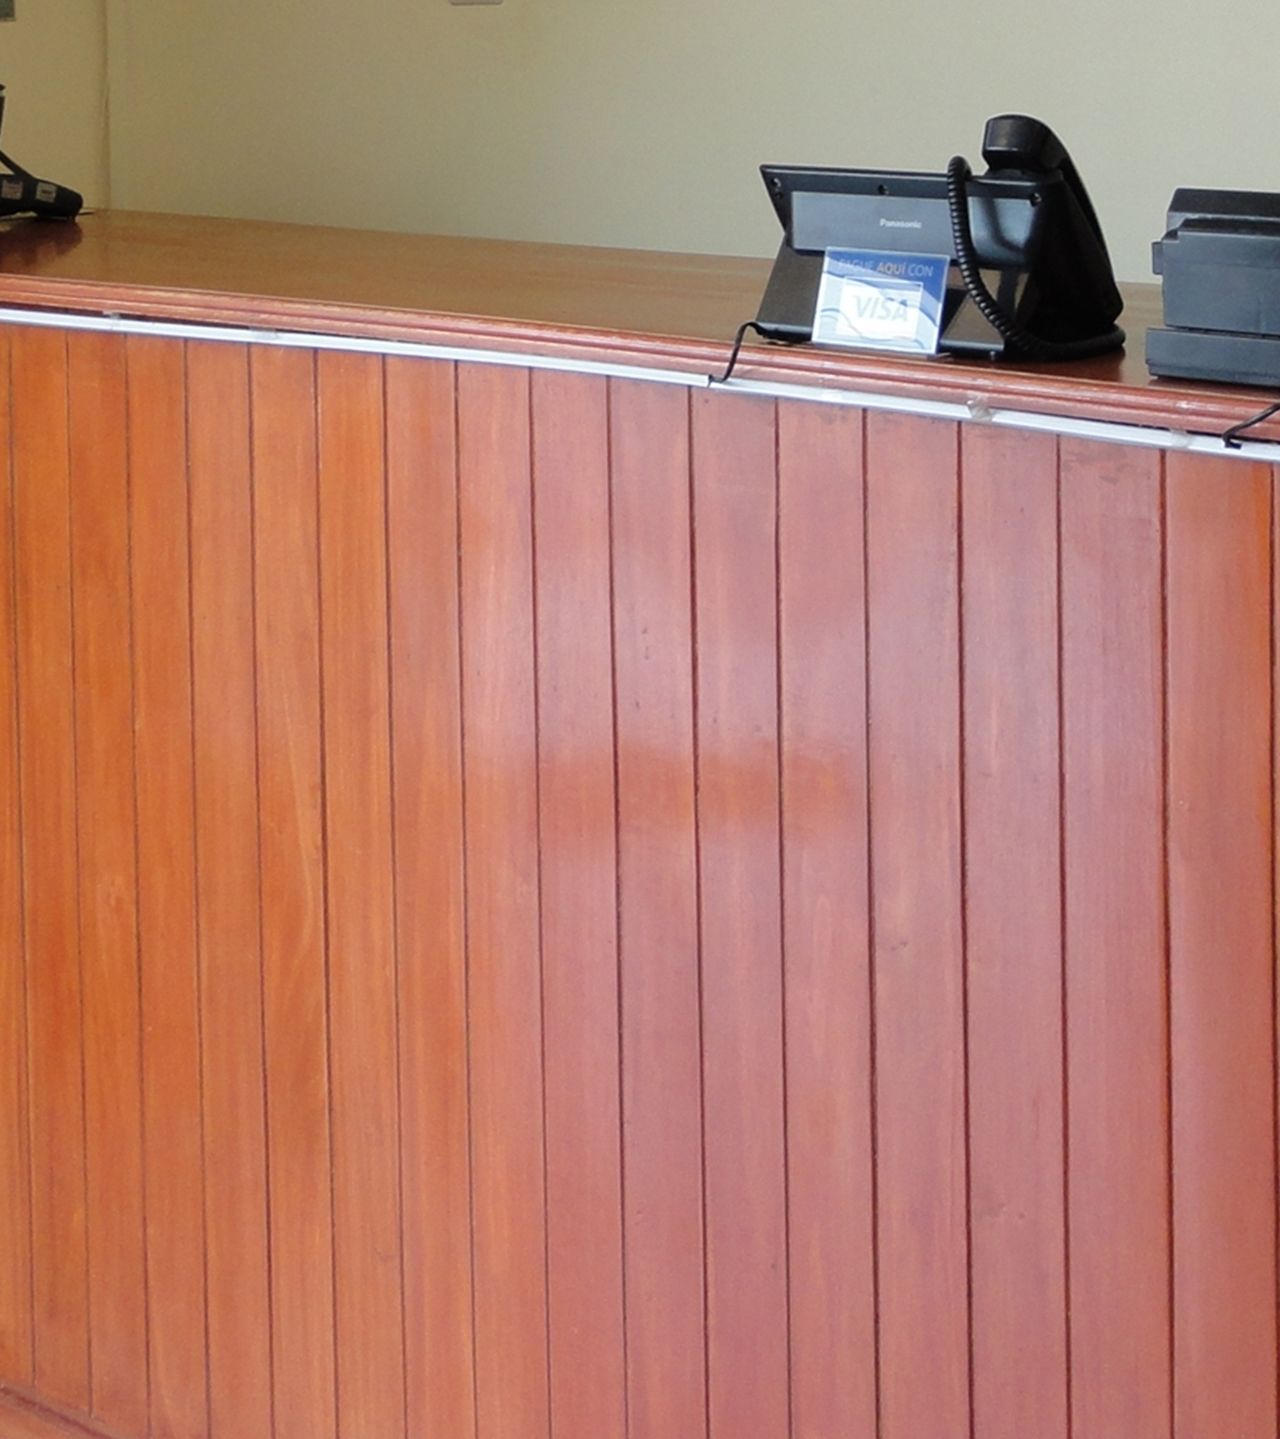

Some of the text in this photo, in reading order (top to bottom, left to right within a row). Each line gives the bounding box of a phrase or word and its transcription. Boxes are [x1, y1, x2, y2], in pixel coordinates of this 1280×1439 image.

[880, 218, 922, 229] Panasonic
[907, 264, 935, 277] CON
[852, 295, 910, 322] VISA
